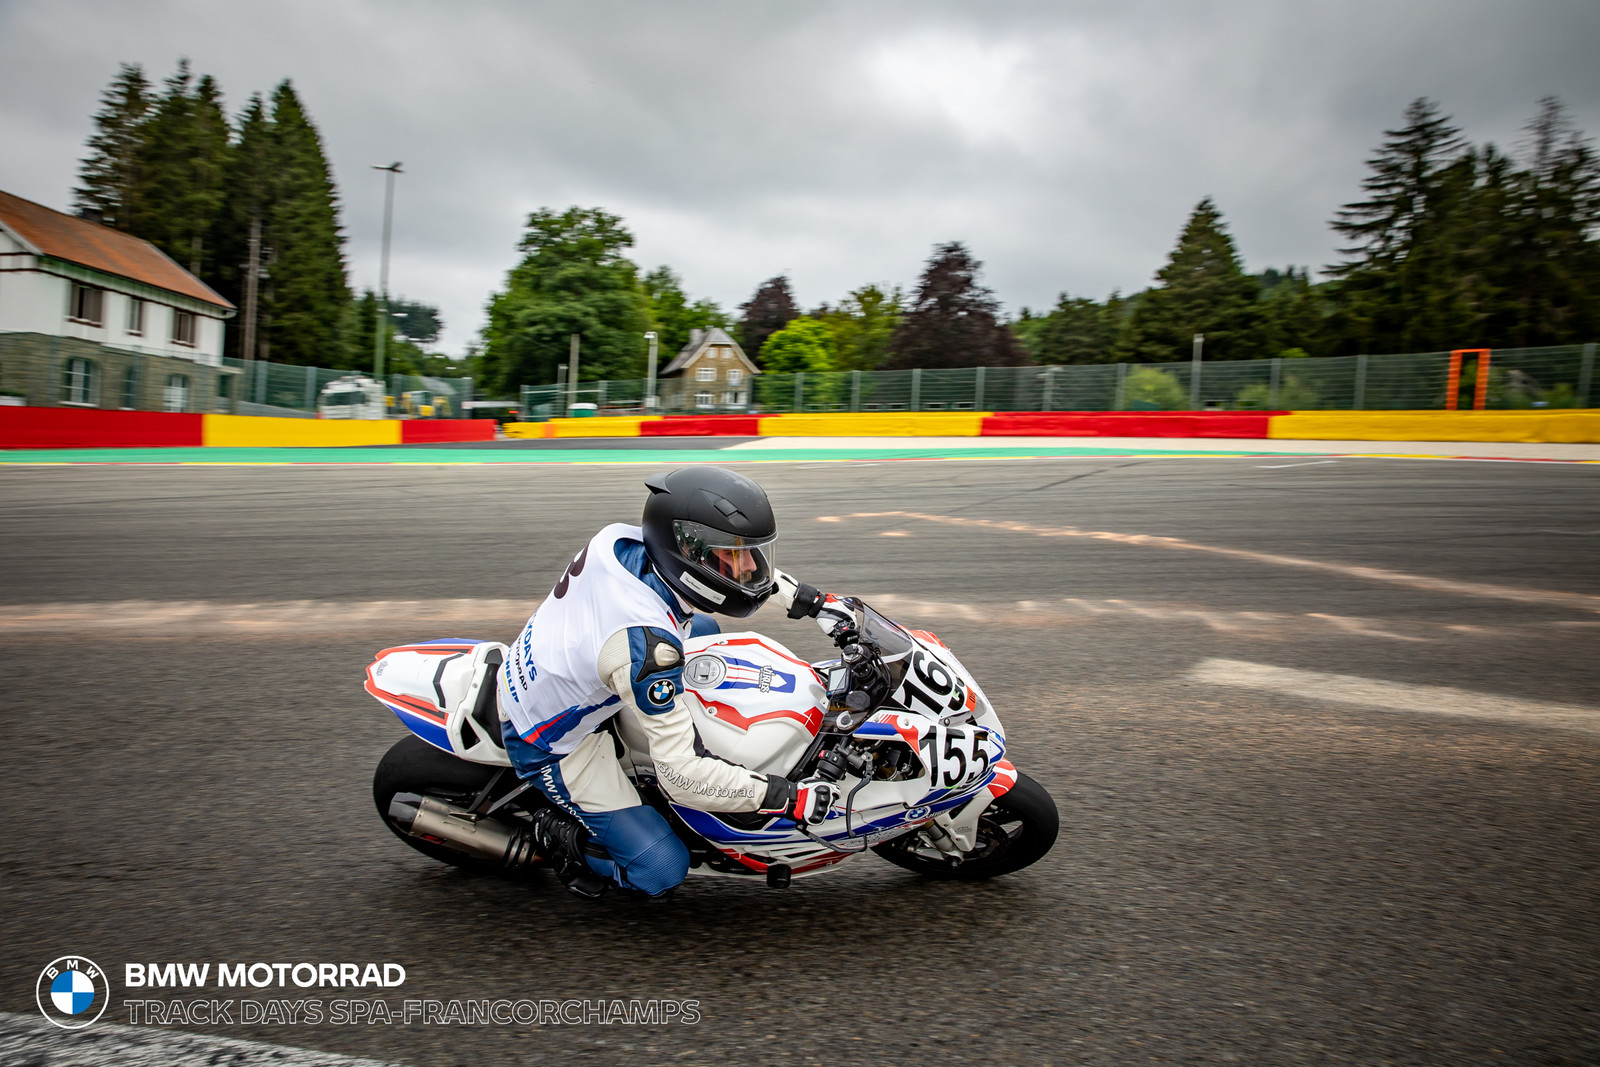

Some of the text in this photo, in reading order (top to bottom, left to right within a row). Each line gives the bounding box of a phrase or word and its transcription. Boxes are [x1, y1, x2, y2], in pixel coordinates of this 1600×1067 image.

[902, 650, 953, 715] 16
[657, 761, 755, 799] BMW Motorrad
[919, 725, 989, 787] 155
